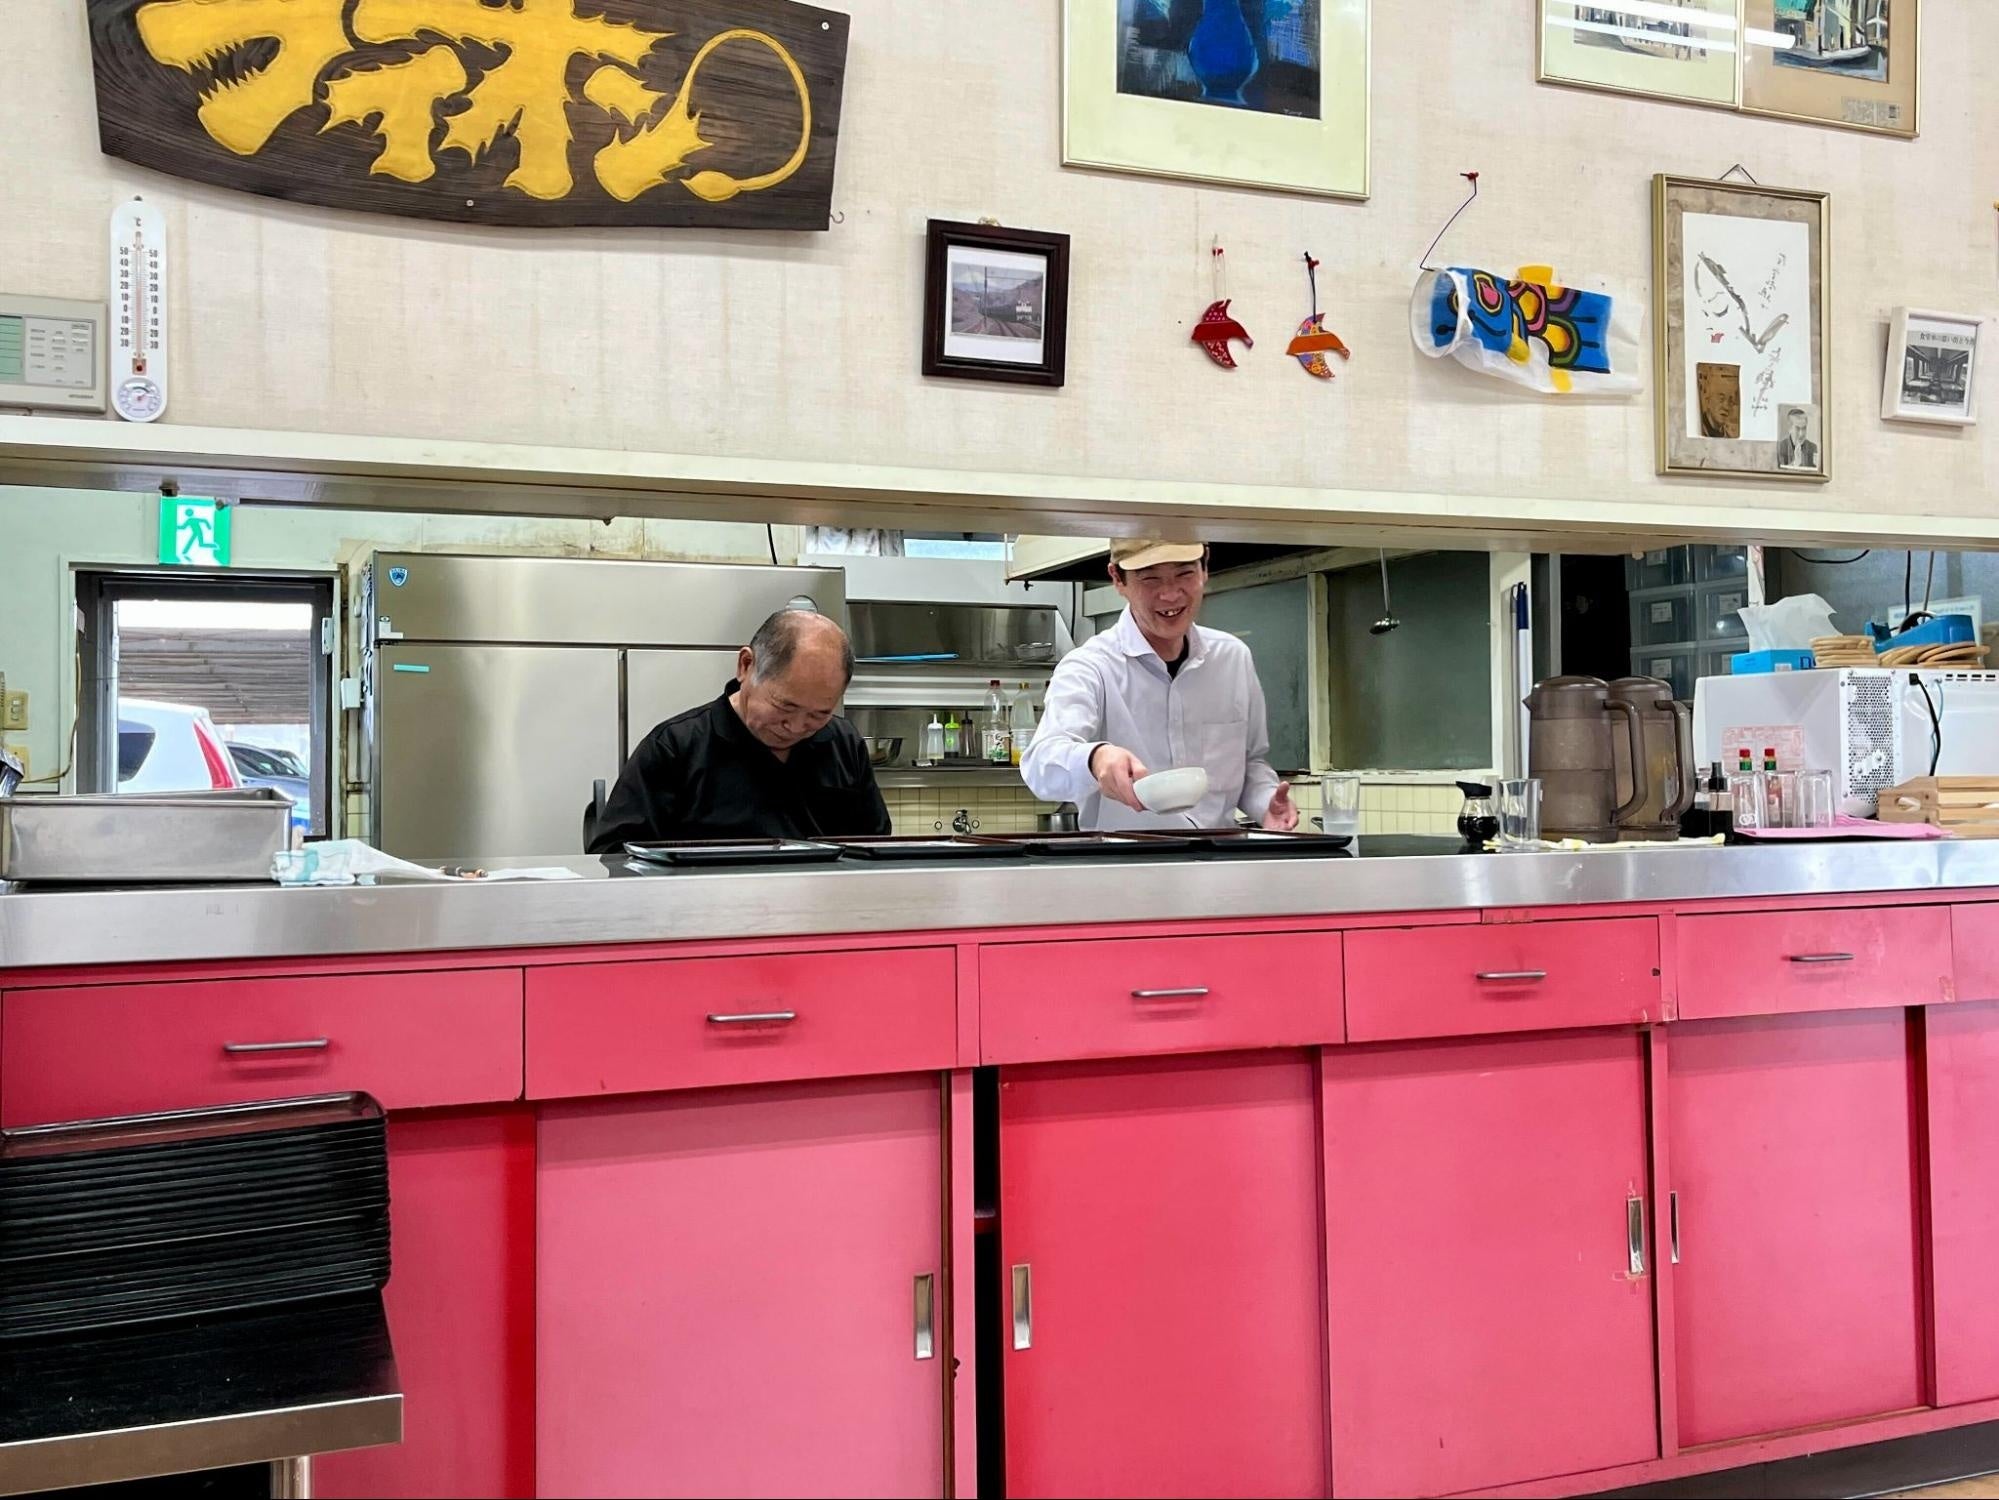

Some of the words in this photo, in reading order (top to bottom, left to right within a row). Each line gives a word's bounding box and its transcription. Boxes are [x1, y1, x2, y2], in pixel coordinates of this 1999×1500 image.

[119, 247, 129, 255] 50
[149, 249, 158, 258] 50
[119, 258, 129, 266] 40
[149, 261, 158, 269] 40
[119, 269, 129, 277] 30
[149, 272, 158, 280] 30
[120, 281, 129, 289] 20
[149, 284, 158, 292] 20
[121, 293, 129, 301] 10
[151, 295, 158, 303] 10
[123, 304, 128, 312] 0
[153, 306, 157, 314] 0
[121, 315, 129, 324] 10
[151, 318, 158, 326] 10
[120, 327, 129, 335] 20
[150, 329, 158, 338] 20
[120, 338, 129, 347] 30
[150, 341, 158, 349] 30
